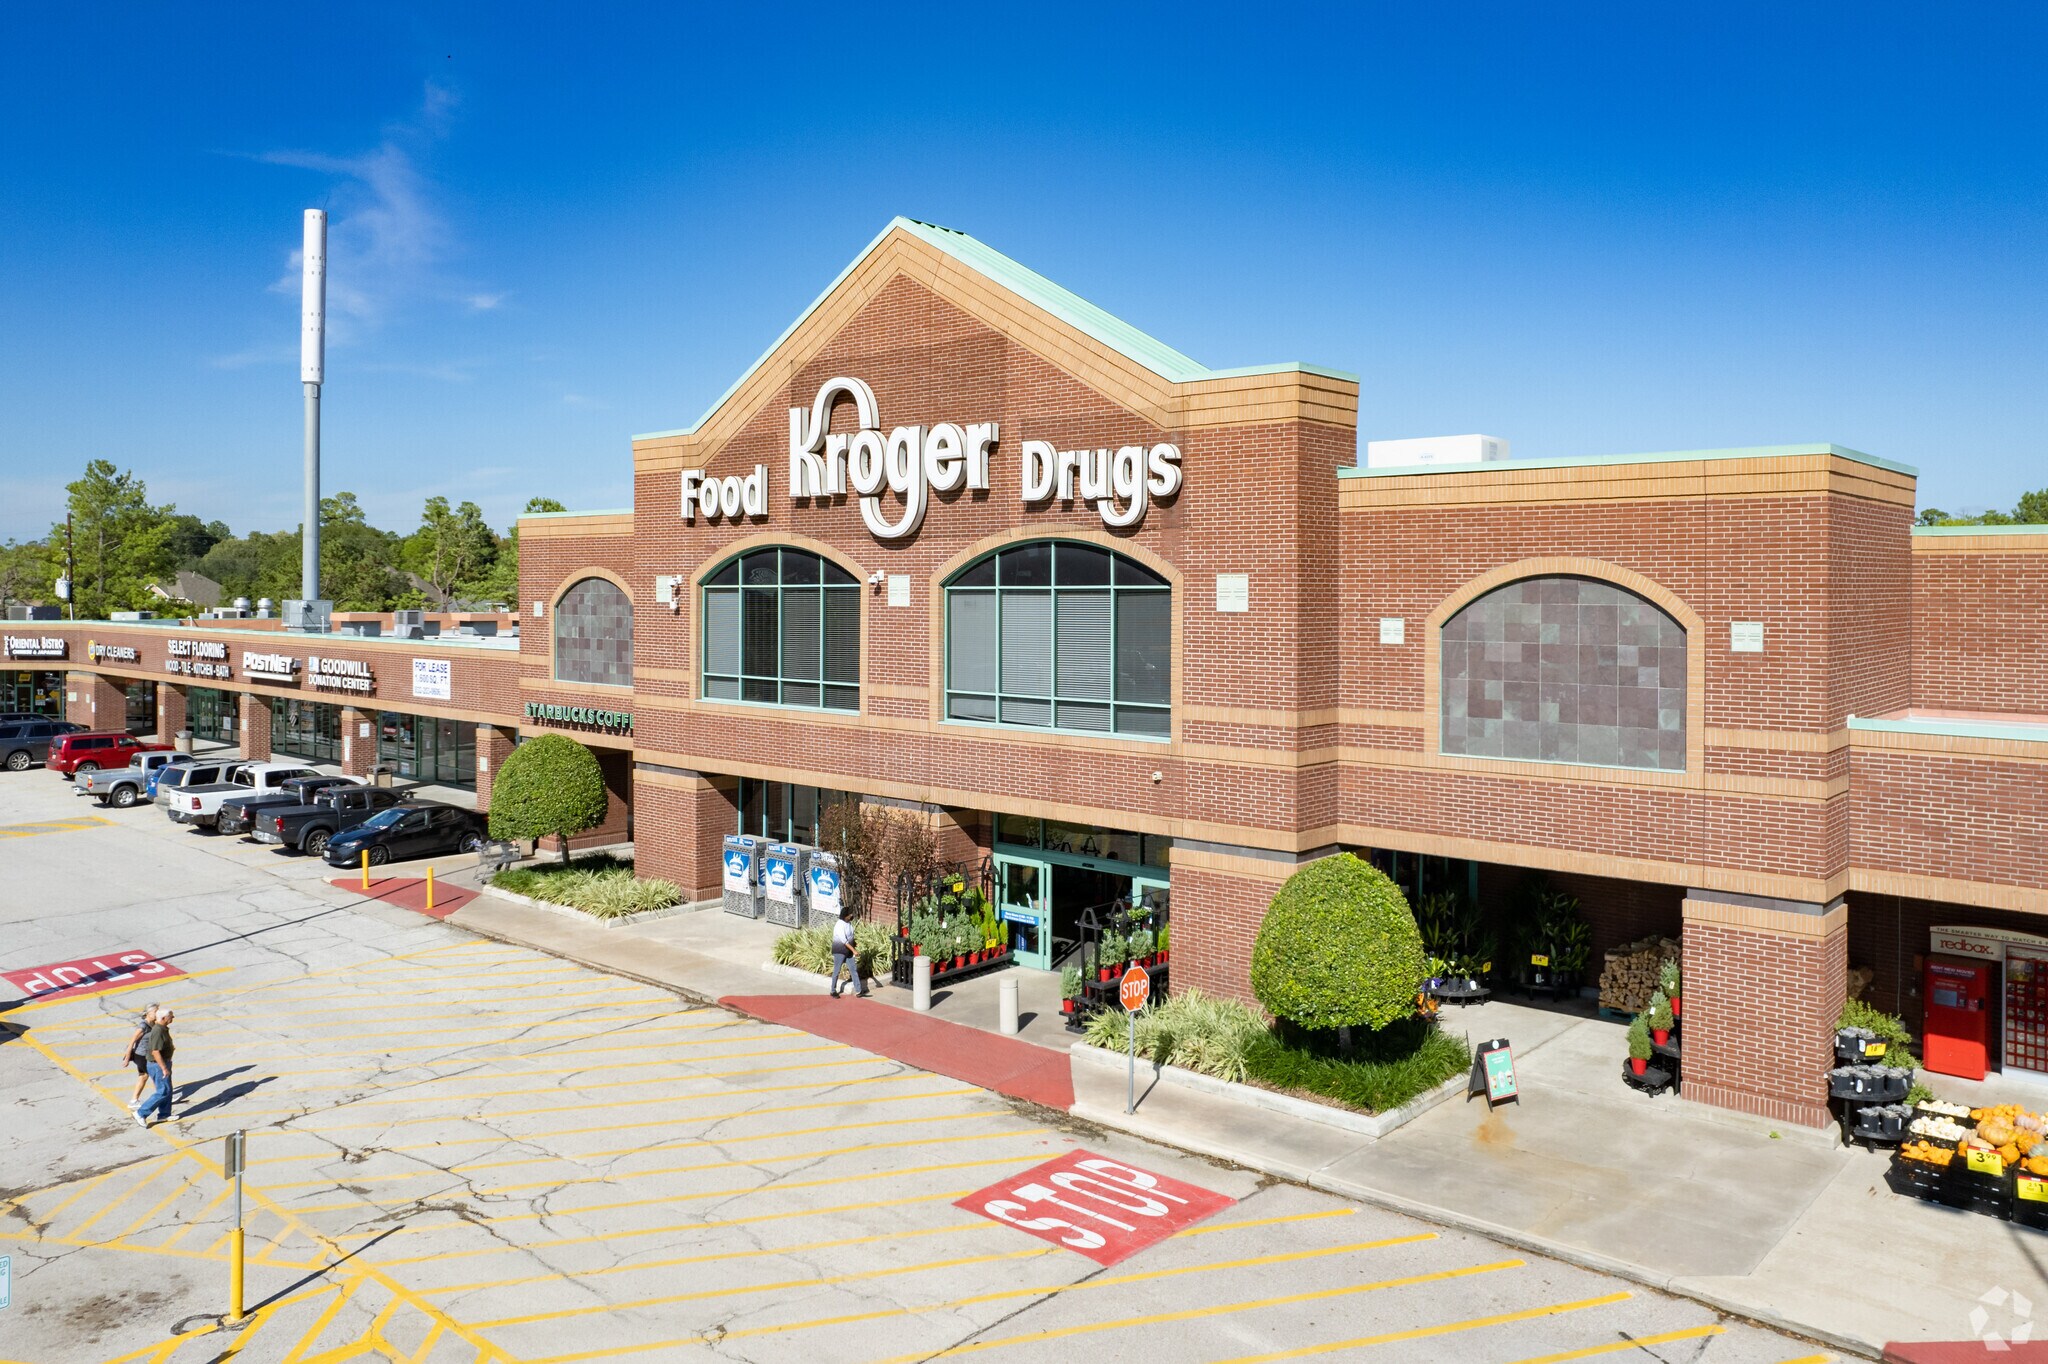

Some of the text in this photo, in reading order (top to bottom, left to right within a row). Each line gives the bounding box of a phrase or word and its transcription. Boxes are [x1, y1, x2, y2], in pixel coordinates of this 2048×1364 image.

[789, 376, 999, 538] Kroger
[681, 464, 768, 519] Food
[1021, 439, 1182, 527] Drugs
[10, 635, 40, 649] ORIENTAL
[41, 636, 65, 650] BISTRO
[95, 645, 135, 659] DRY CLEANERS
[168, 639, 225, 659] SELECT FLOORING
[165, 660, 229, 678] WOOD TILE KITCHEN BATH
[243, 651, 293, 673] POSTNET
[321, 658, 370, 677] GOODWILL
[415, 661, 448, 674] FOR LEASE
[308, 673, 370, 691] DONATION CENTER
[524, 702, 595, 725] STARBUCKS
[1951, 929, 1982, 937] SMARTER
[2012, 937, 2036, 945] WATCH
[24, 954, 166, 995] STOP
[1122, 979, 1147, 999] STOP
[983, 1158, 1190, 1250] STOP
